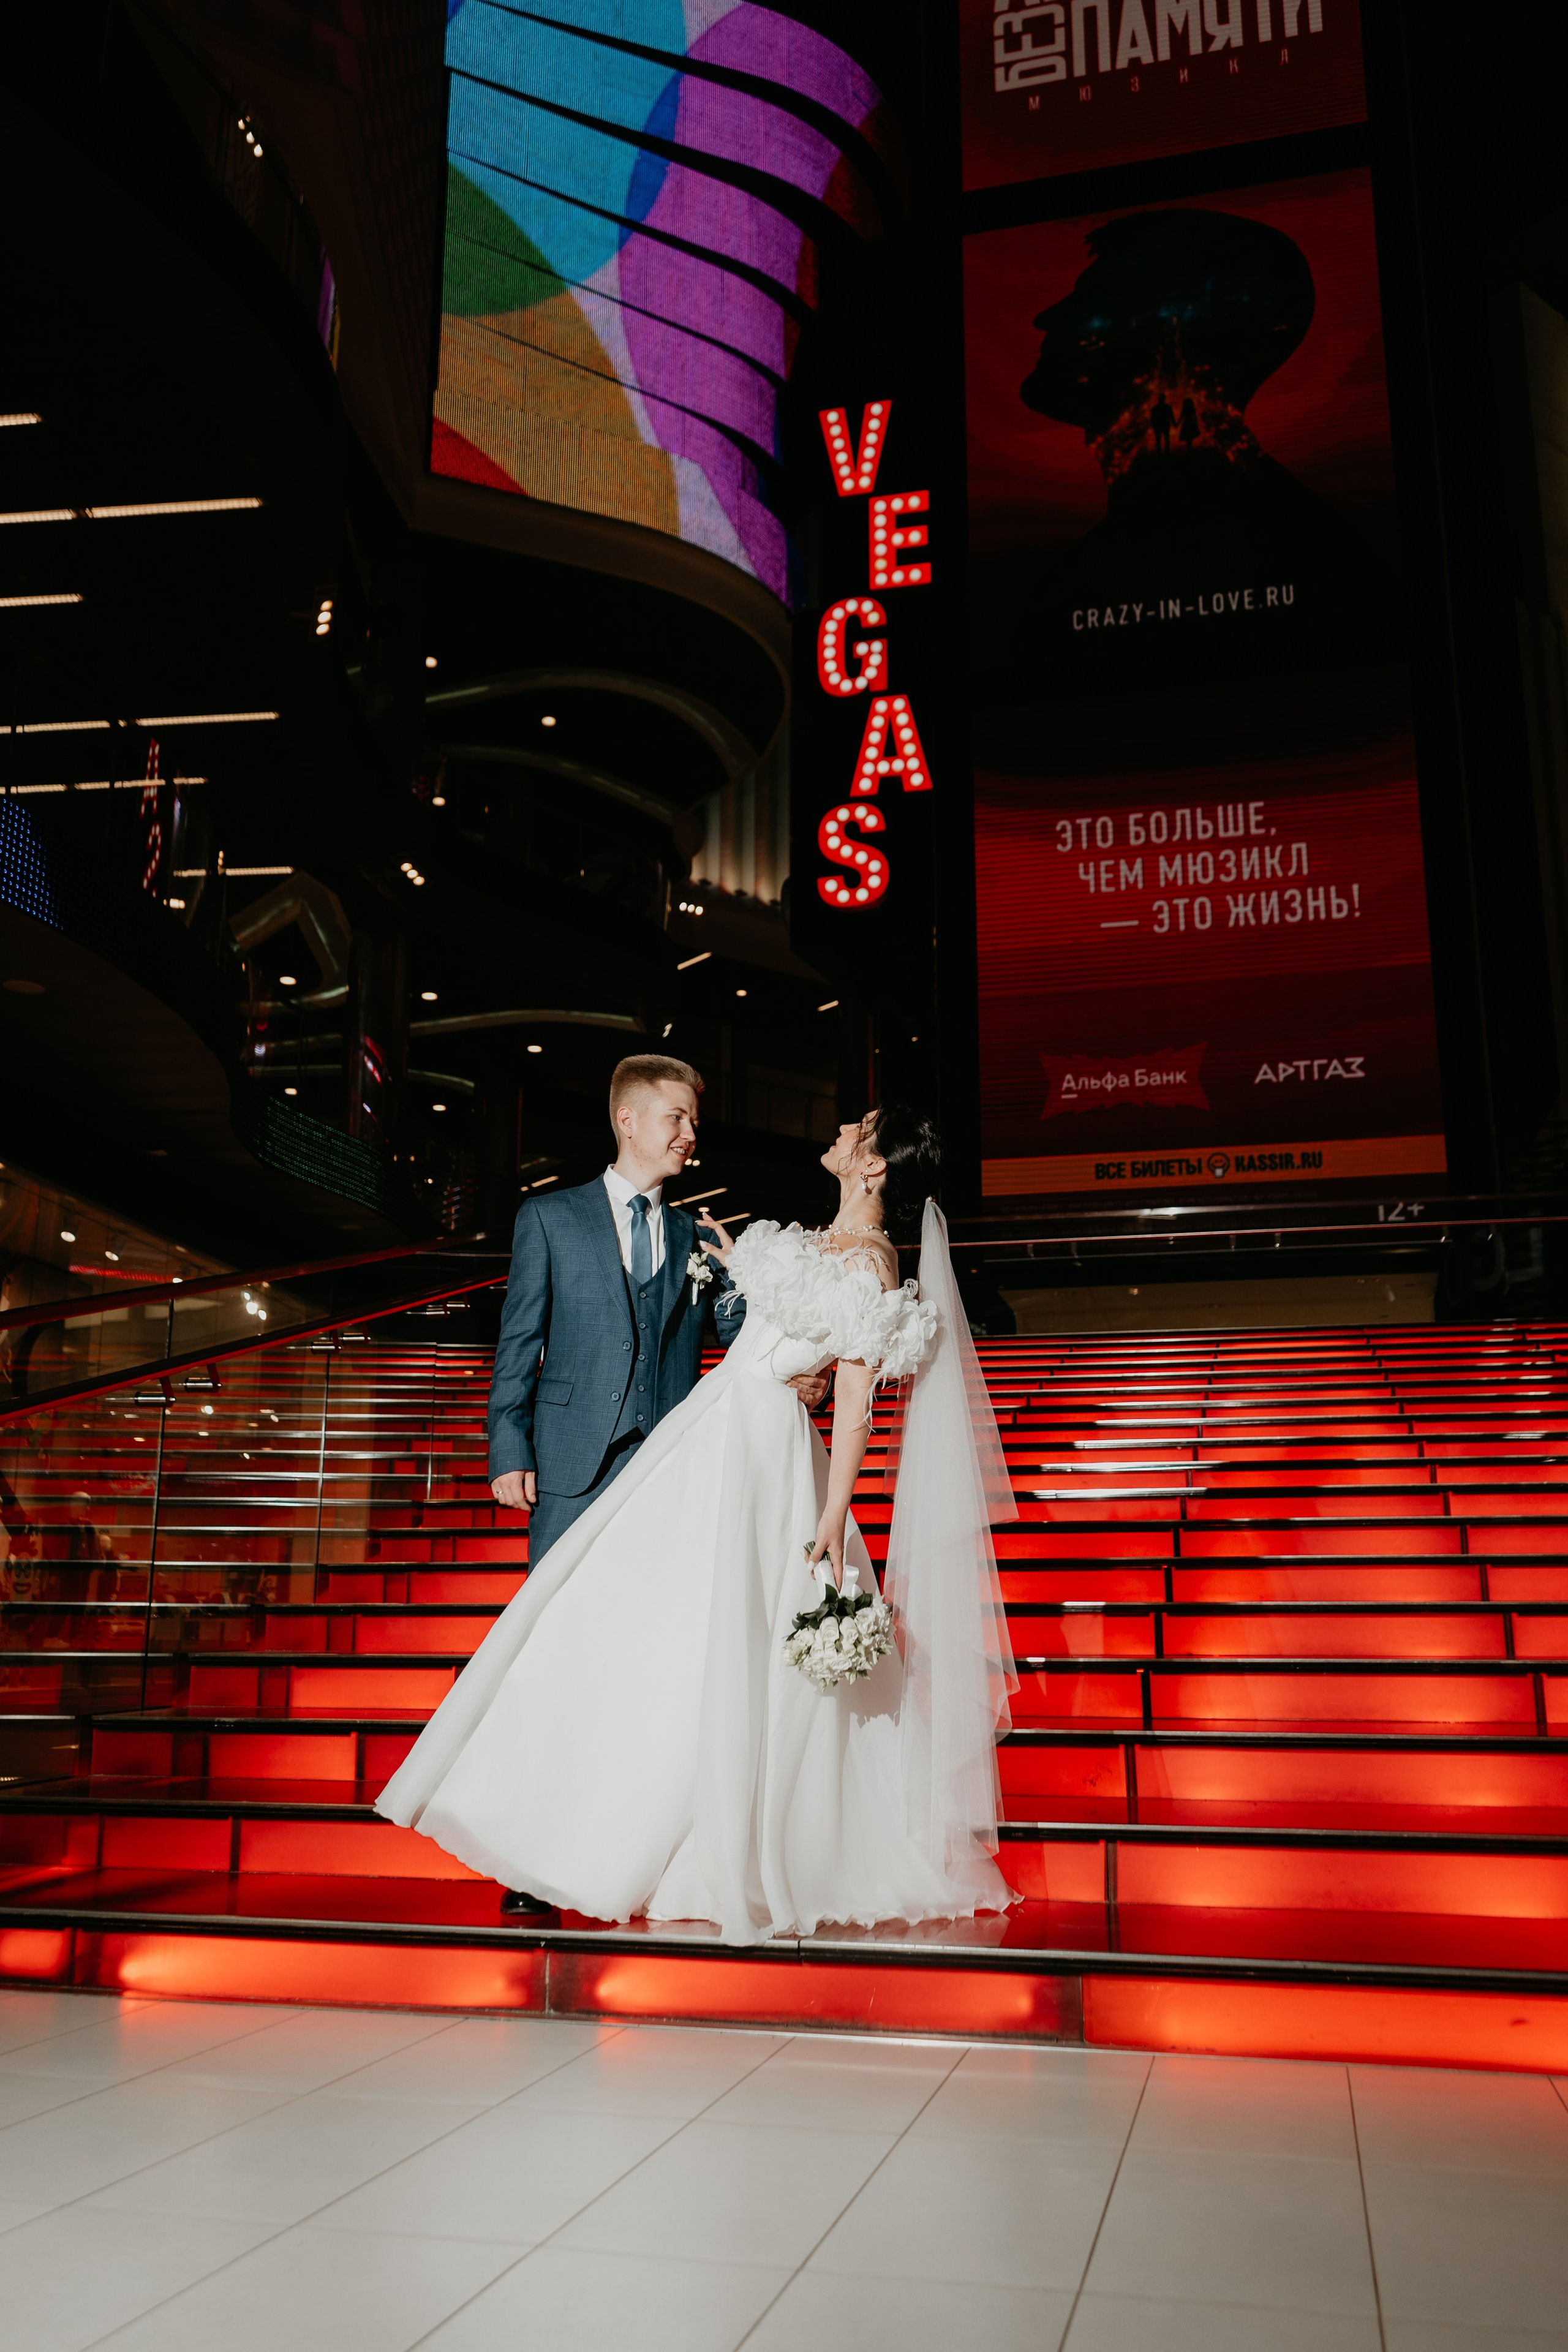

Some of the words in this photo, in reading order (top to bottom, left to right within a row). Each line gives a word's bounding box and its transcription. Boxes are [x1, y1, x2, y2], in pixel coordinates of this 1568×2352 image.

[1028, 48, 1290, 111] МЮЗИКЛ
[1072, 584, 1294, 630] CRAZY-IN-LOVE.RU
[817, 399, 933, 908] VEGAS
[1055, 816, 1114, 853] ЭТО
[1129, 801, 1278, 846] БОЛЬШЕ,
[1078, 858, 1144, 894] ЧЕМ
[1159, 842, 1310, 888] МЮЗИКЛ
[1152, 896, 1212, 933] ЭТО
[1226, 883, 1361, 927] ЖИЗНЬ!
[1061, 1071, 1129, 1092] Альфа
[1134, 1068, 1187, 1087] Банк
[1095, 1161, 1127, 1180] ВСЕ
[1130, 1157, 1203, 1178] БИЛЕТЫ
[1234, 1151, 1324, 1172] KASSIR.RU
